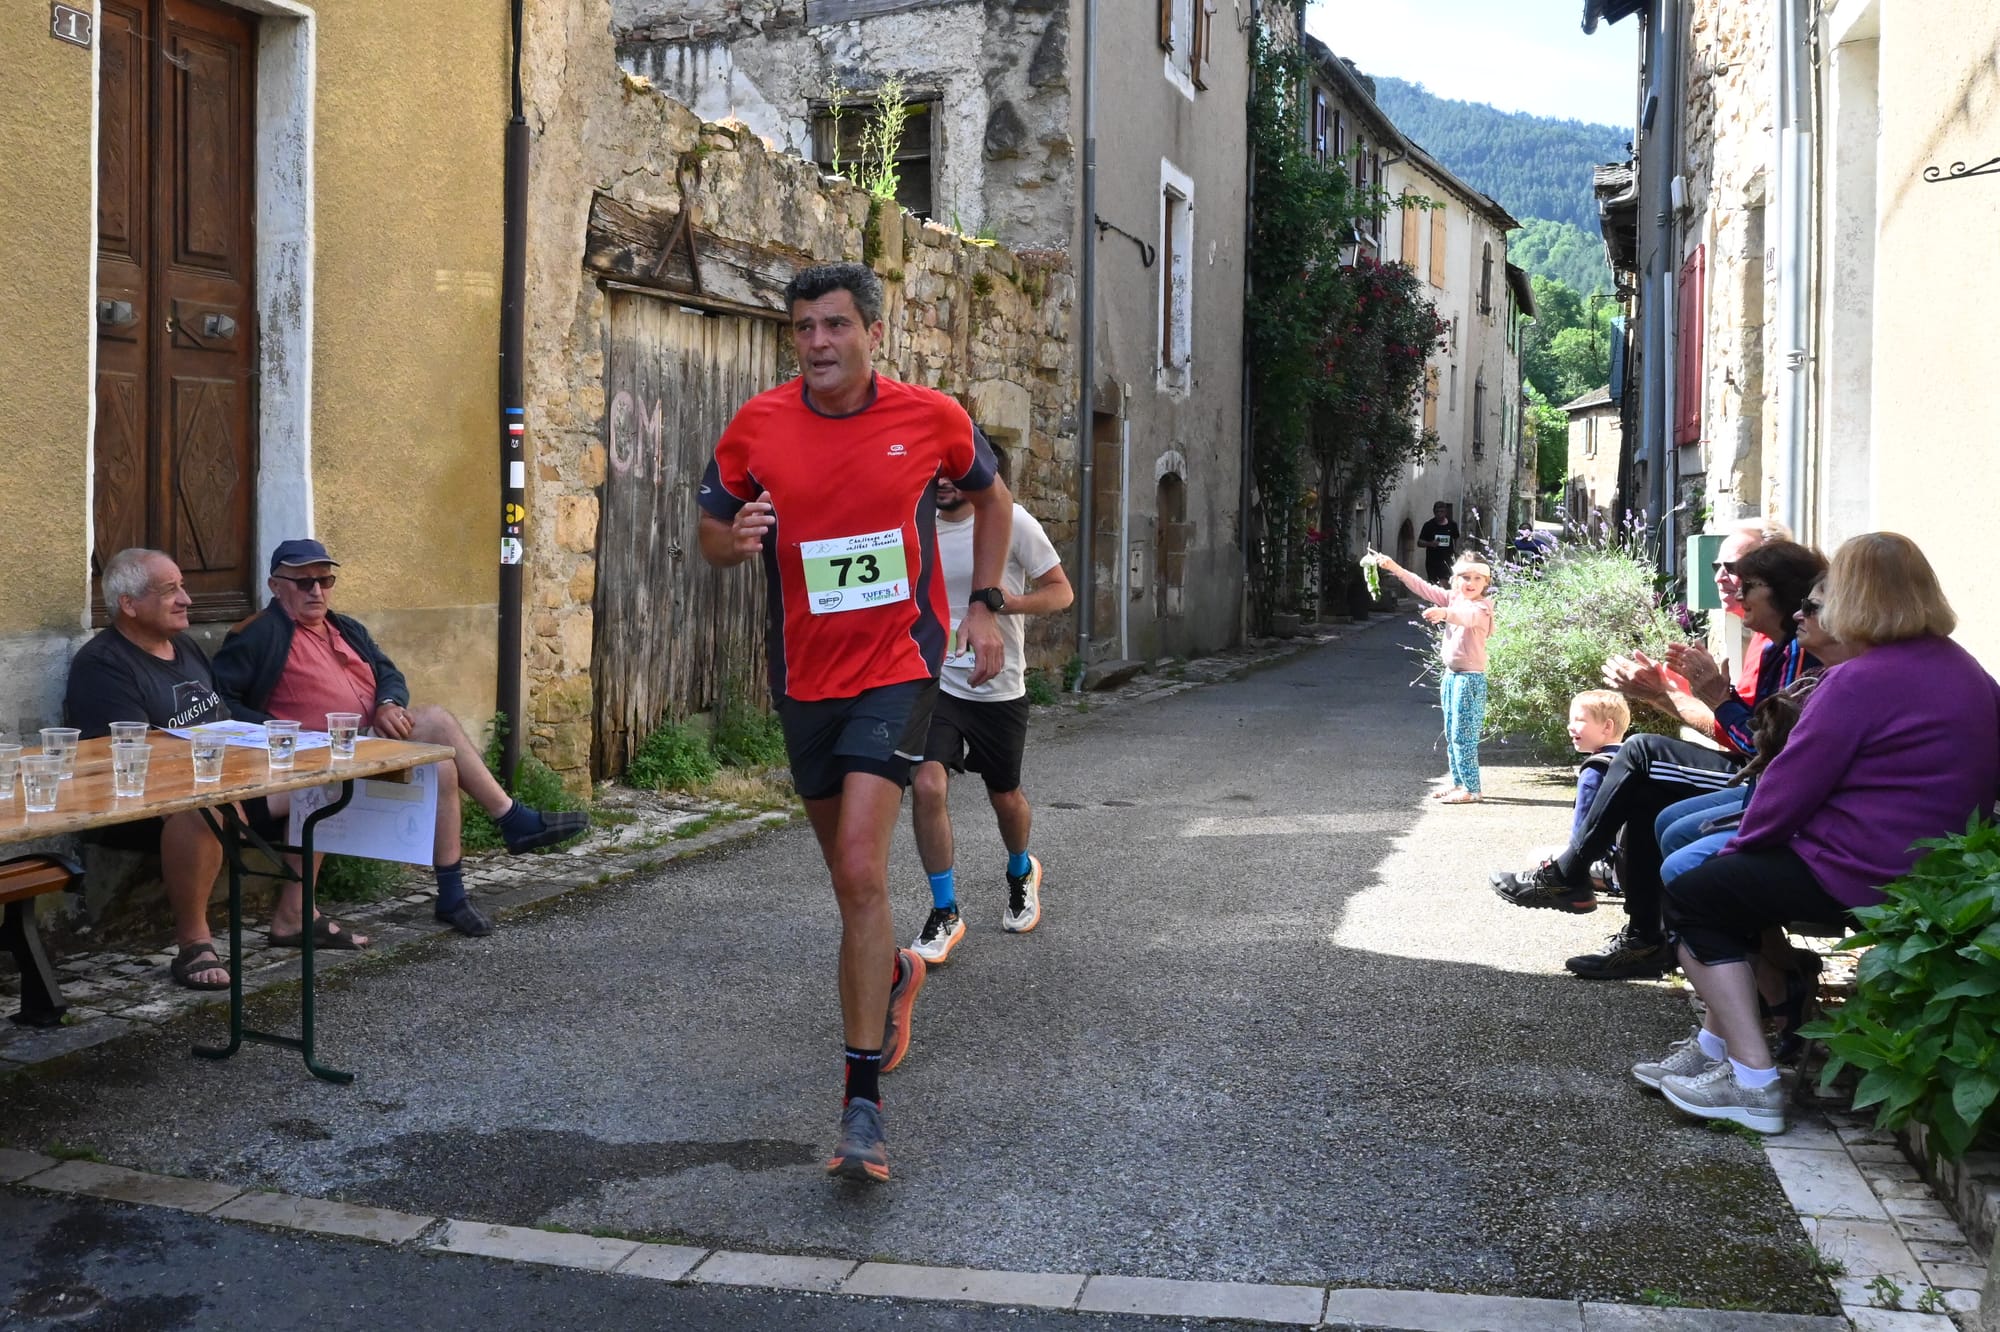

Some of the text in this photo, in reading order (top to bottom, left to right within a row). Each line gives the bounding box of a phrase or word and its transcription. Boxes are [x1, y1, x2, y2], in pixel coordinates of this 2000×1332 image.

[68, 13, 77, 38] 1
[830, 555, 880, 587] 73
[168, 692, 220, 728] QUIKSILVE
